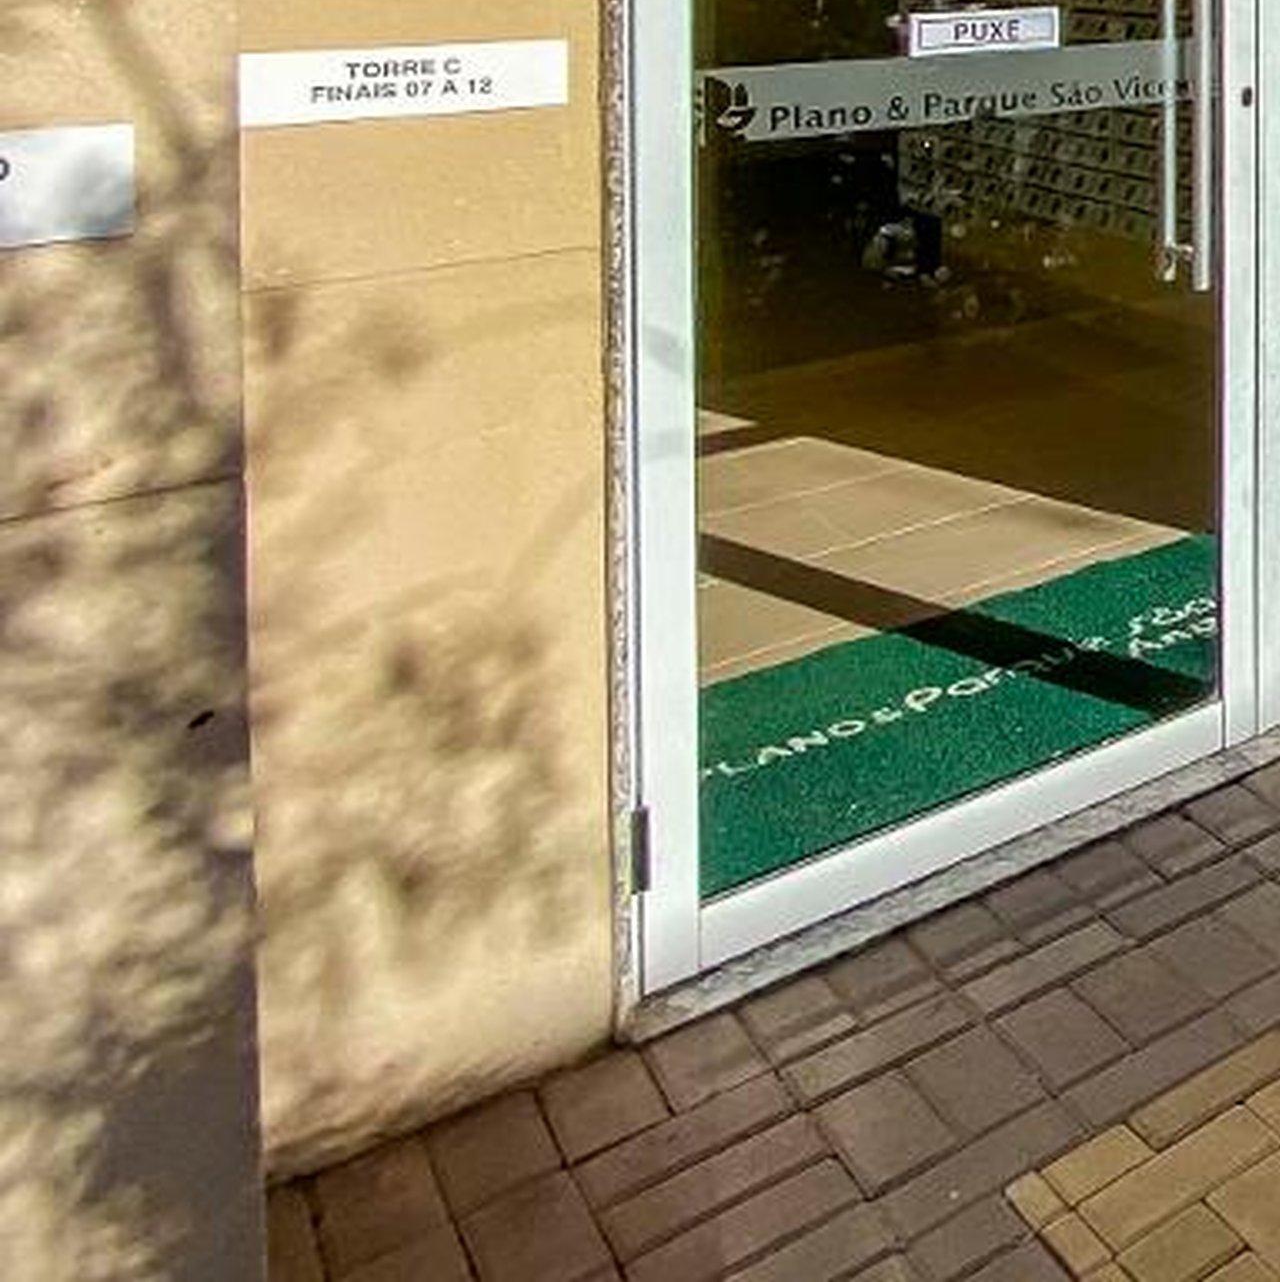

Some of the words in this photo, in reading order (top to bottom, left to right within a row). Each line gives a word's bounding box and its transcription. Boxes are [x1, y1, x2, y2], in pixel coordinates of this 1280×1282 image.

[953, 19, 1020, 41] PUXE
[345, 59, 436, 80] TORRE
[443, 58, 462, 75] C
[310, 82, 397, 104] FINAIS
[405, 80, 433, 98] 07
[441, 78, 459, 96] A
[468, 76, 493, 95] 12
[769, 105, 872, 131] Plano
[887, 96, 909, 120] &
[923, 91, 1037, 119] Parque
